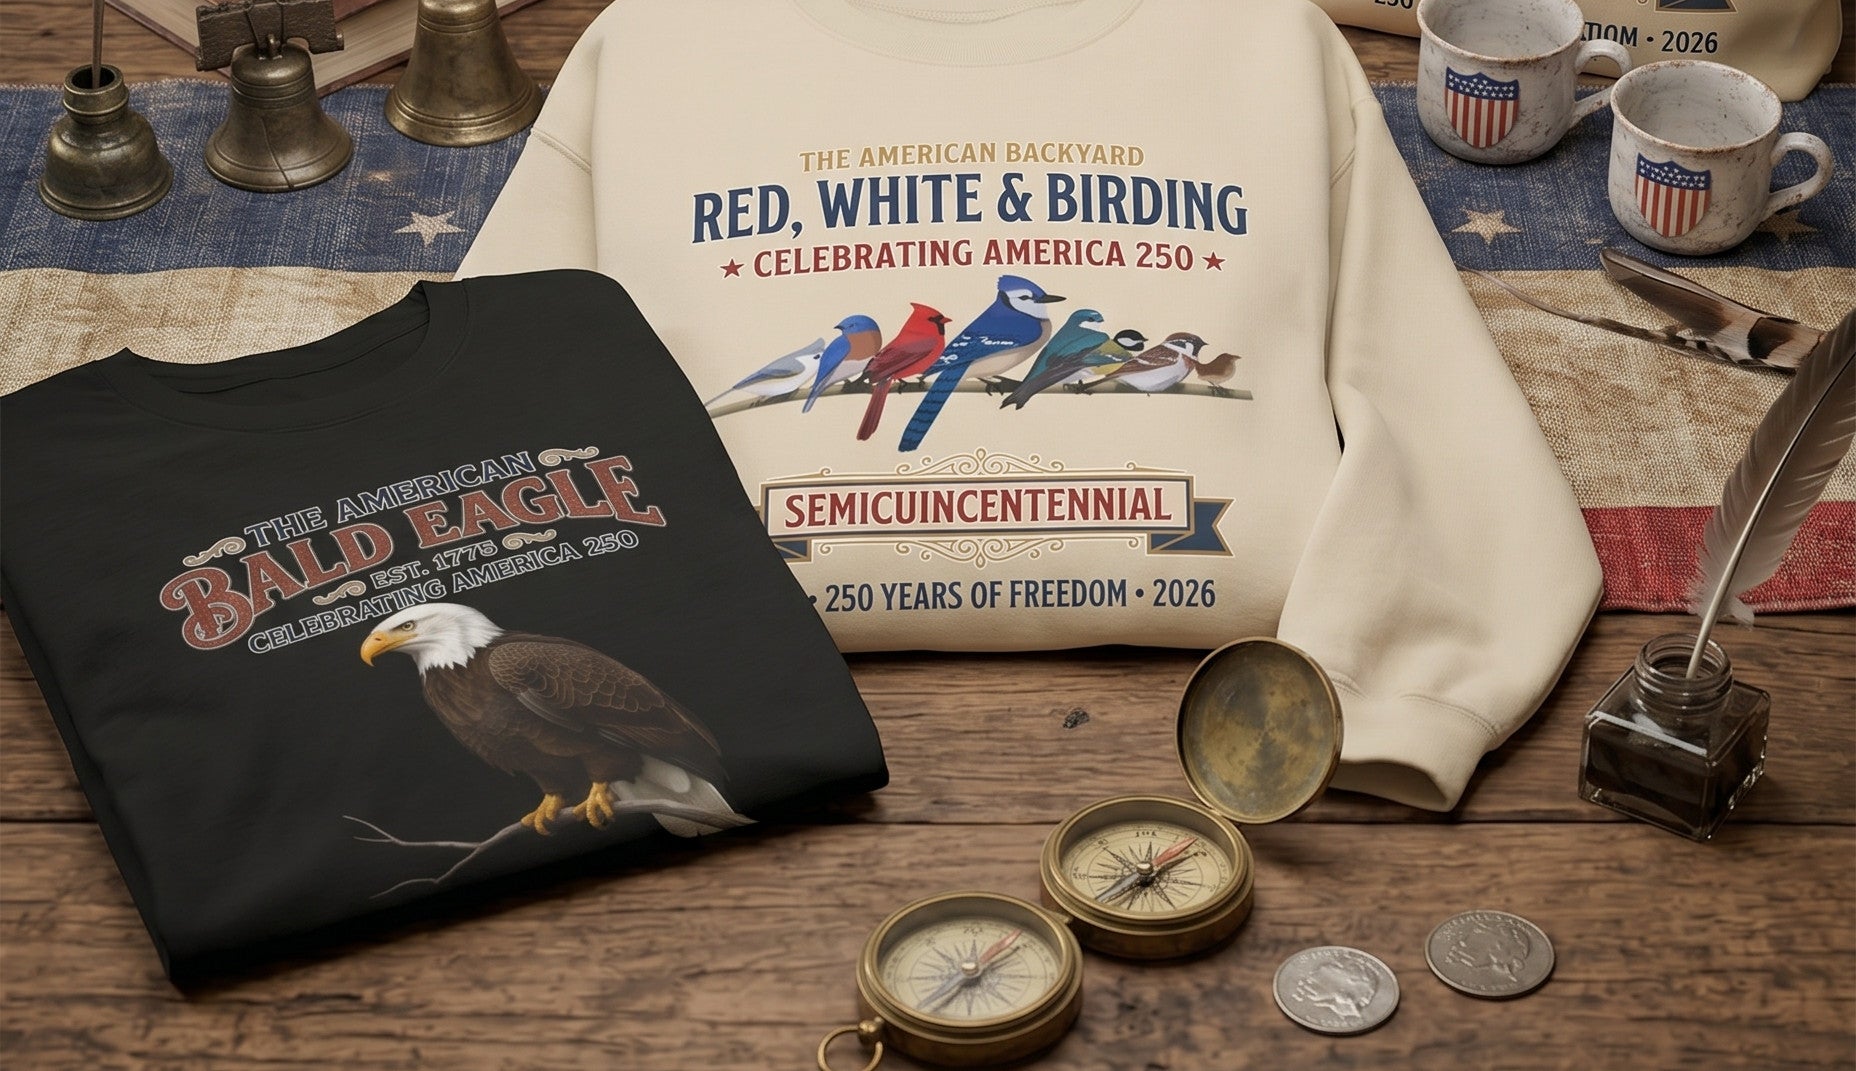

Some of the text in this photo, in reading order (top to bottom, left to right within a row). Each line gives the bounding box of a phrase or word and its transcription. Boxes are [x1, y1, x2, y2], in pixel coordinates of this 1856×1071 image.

[1661, 30, 1719, 53] 2026
[800, 142, 1145, 172] THE AMERICAN BACKYARD
[692, 172, 1248, 244] RED, WHITE & BIRDING
[754, 239, 1194, 278] CELEBRATING AMERICA 250
[244, 451, 536, 547] THE AMERICAN
[784, 487, 1173, 528] SEMICUINCENTENNIAL
[159, 455, 667, 651] BALD EAGLE
[248, 530, 639, 654] CELEBRATING AMERICA 250
[370, 560, 430, 590] EST.
[825, 578, 1216, 612] 250 YEARS OF FREEDOM 2026
